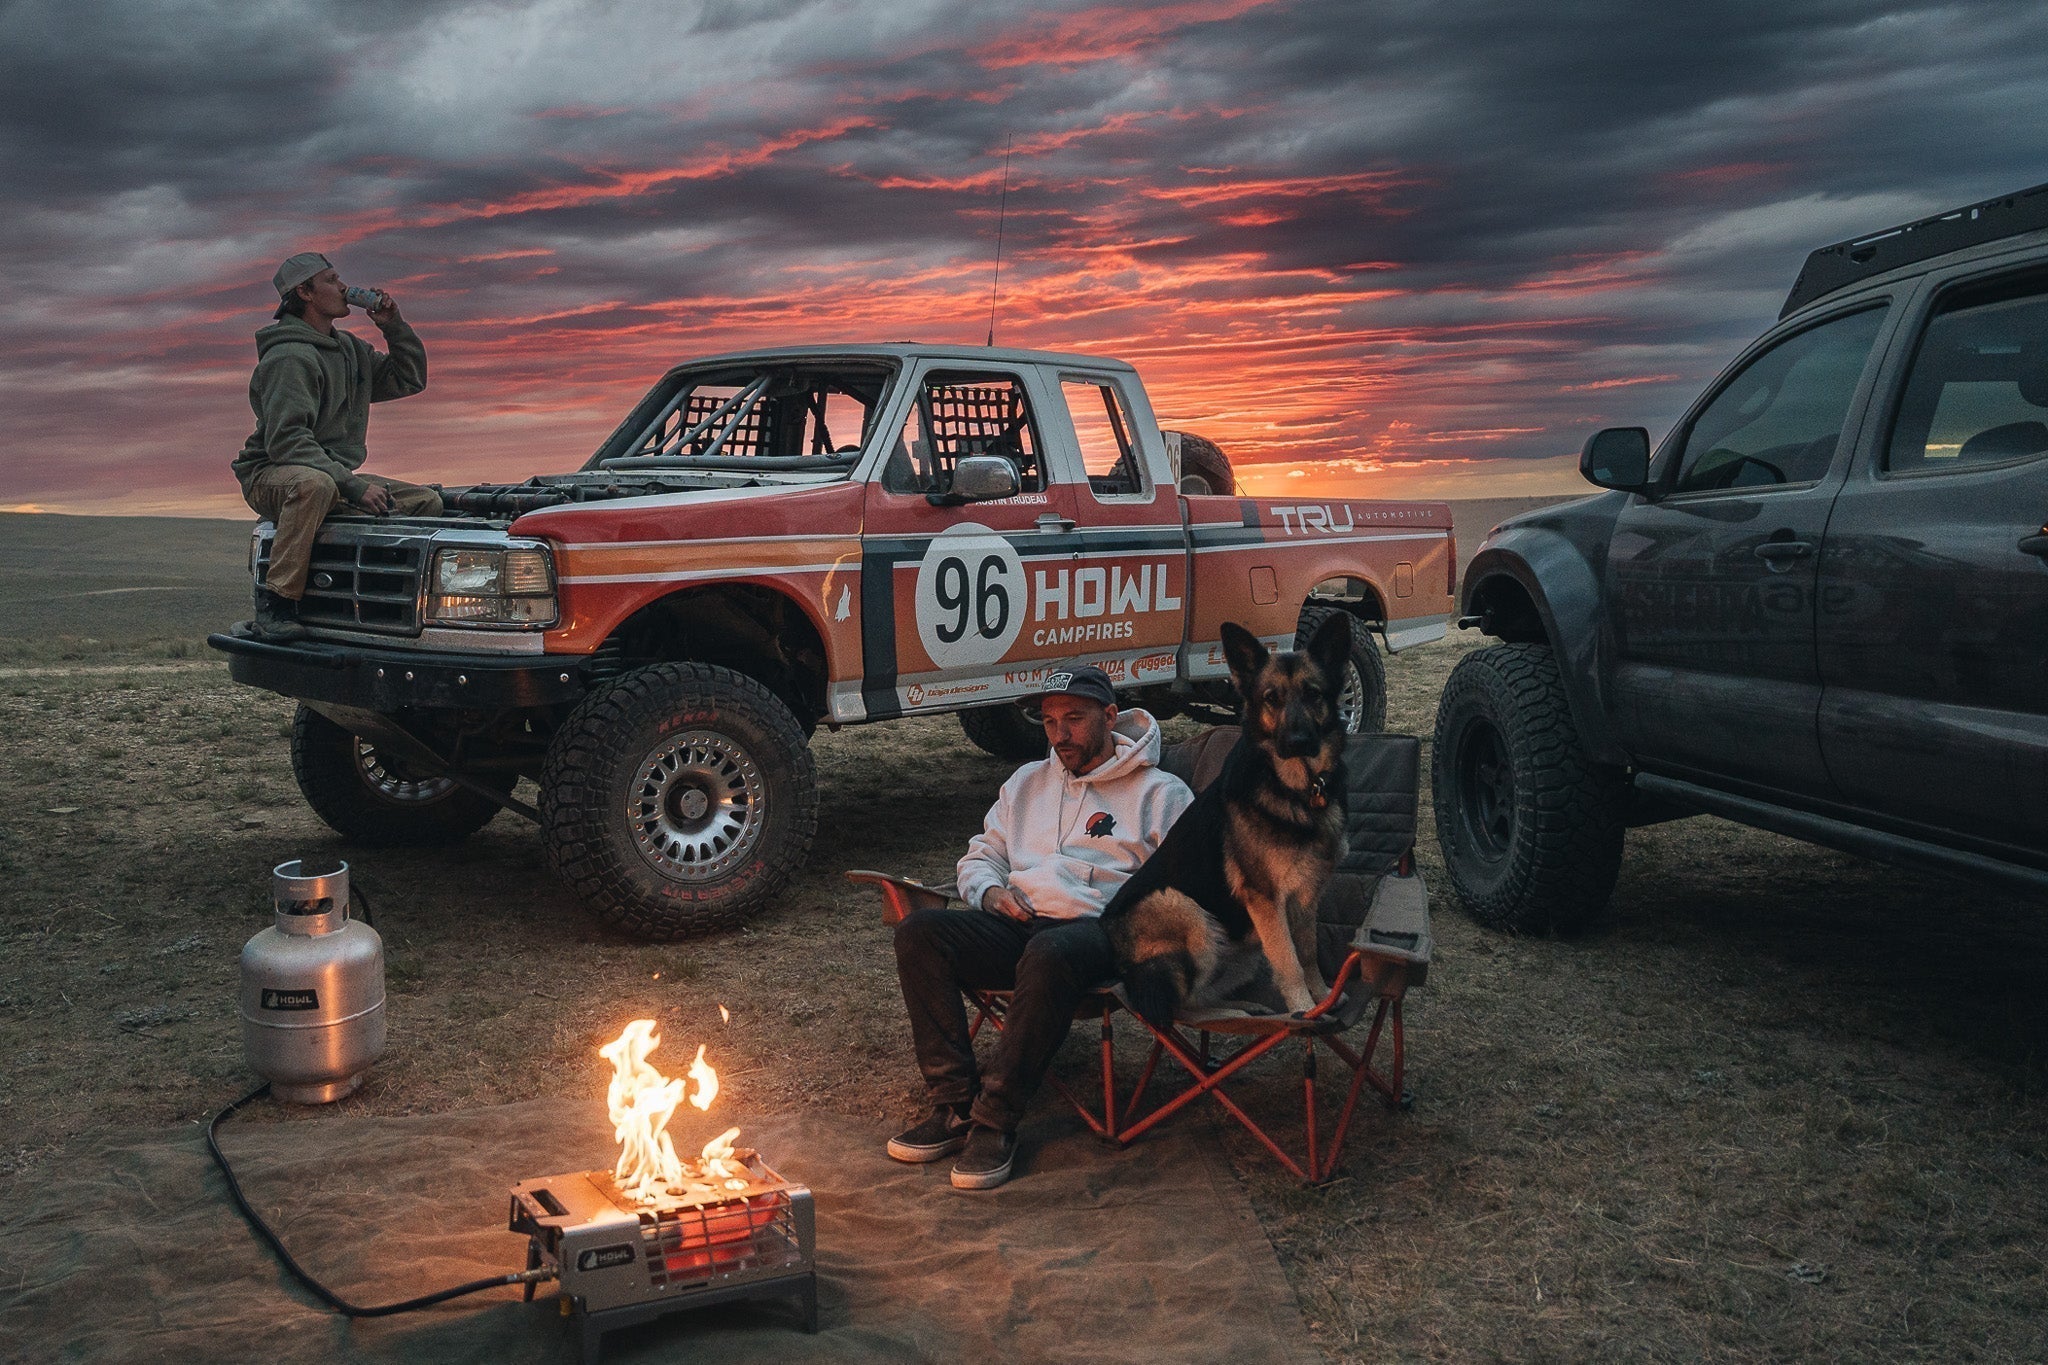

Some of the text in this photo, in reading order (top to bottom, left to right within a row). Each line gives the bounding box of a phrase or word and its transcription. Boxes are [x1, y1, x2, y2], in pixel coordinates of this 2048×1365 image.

[1009, 495, 1048, 505] TRUDEAU
[1270, 504, 1433, 535] TRU AUTOMOTIVE
[935, 554, 1009, 643] 96
[1035, 563, 1182, 622] HOWL
[1033, 620, 1133, 646] CAMPFIRES
[1090, 659, 1125, 674] NDA
[1004, 667, 1054, 684] NOMA
[280, 995, 313, 1004] HOWL
[599, 1250, 630, 1261] HOWL
